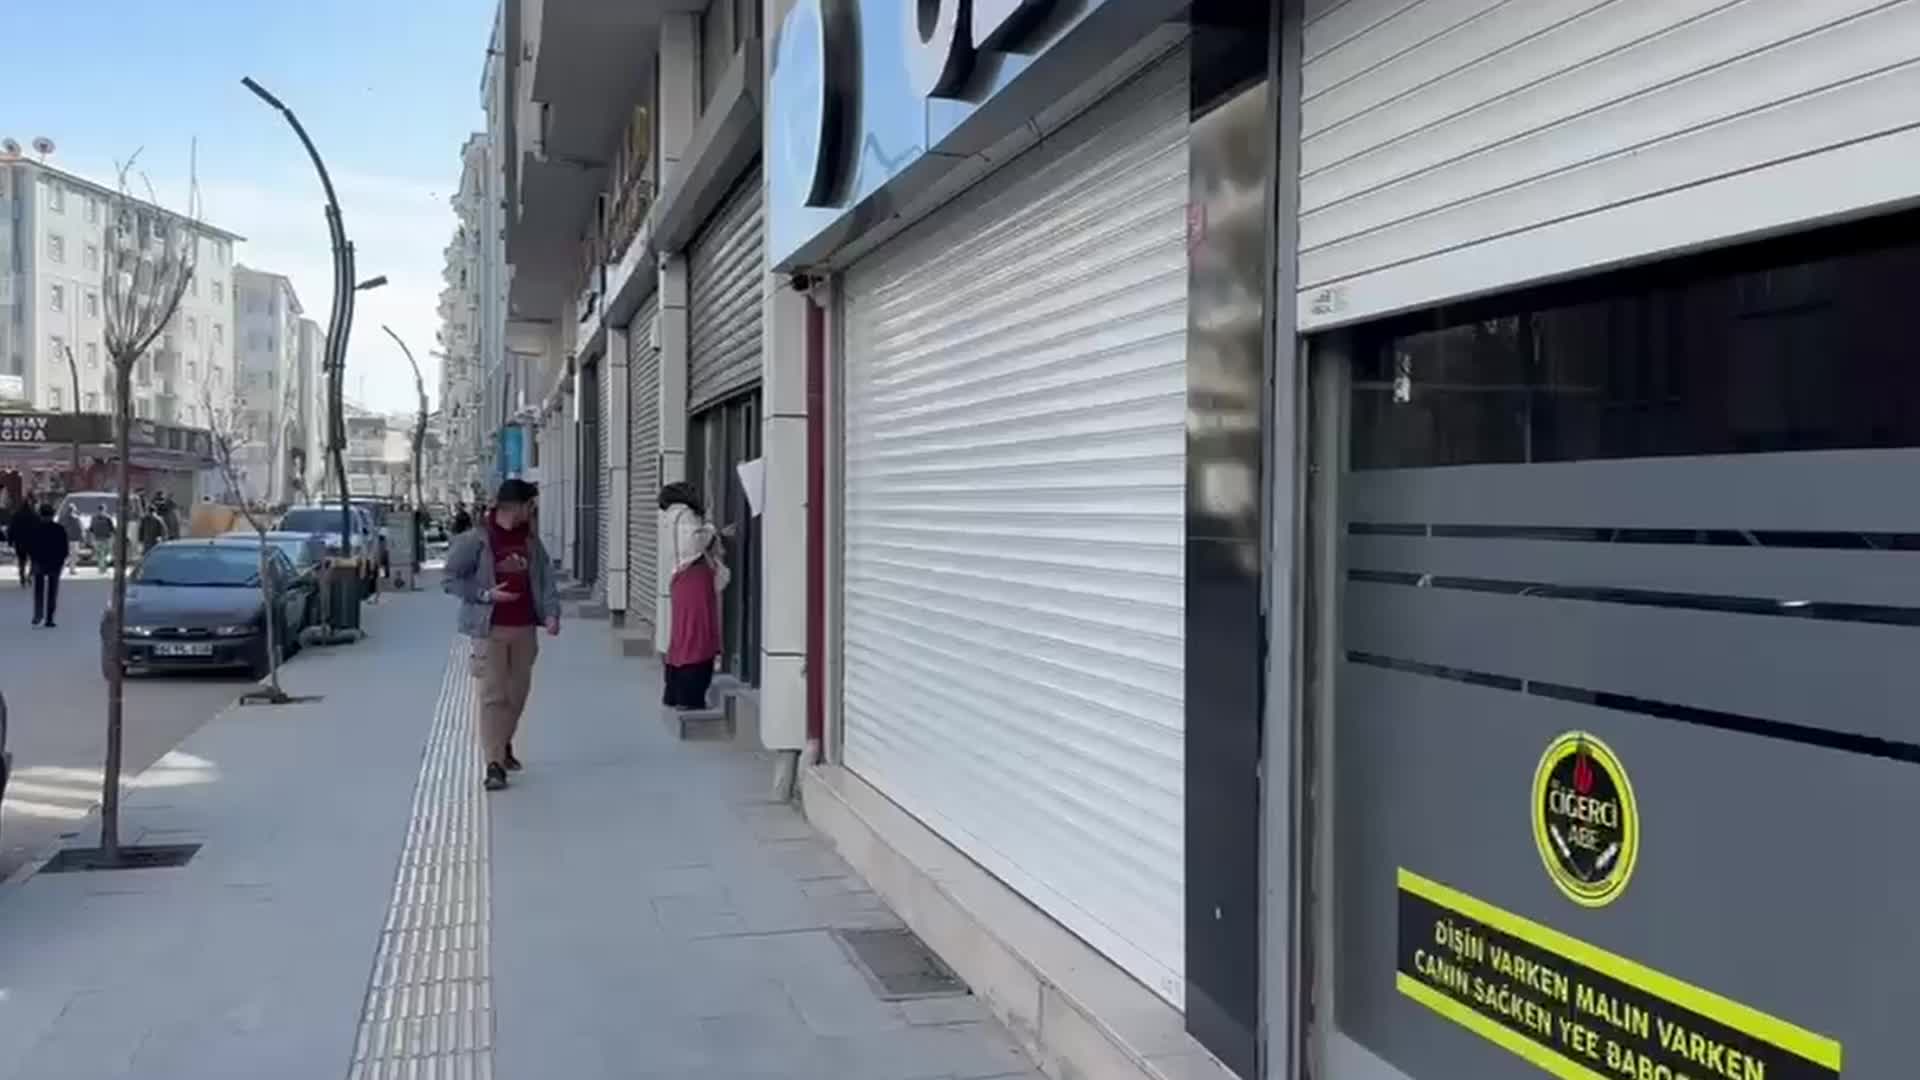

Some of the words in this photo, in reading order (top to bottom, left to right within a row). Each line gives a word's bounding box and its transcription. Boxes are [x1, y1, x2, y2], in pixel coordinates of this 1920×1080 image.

[1414, 948, 1469, 995] CANIN
[1559, 1015, 1600, 1060] YEE
[1606, 1040, 1692, 1080] BABO
[1434, 919, 1485, 963] DİŞİN
[1490, 945, 1569, 1003] VARKEN
[1576, 983, 1649, 1040] MALIN
[1656, 1016, 1766, 1080] VARKEN
